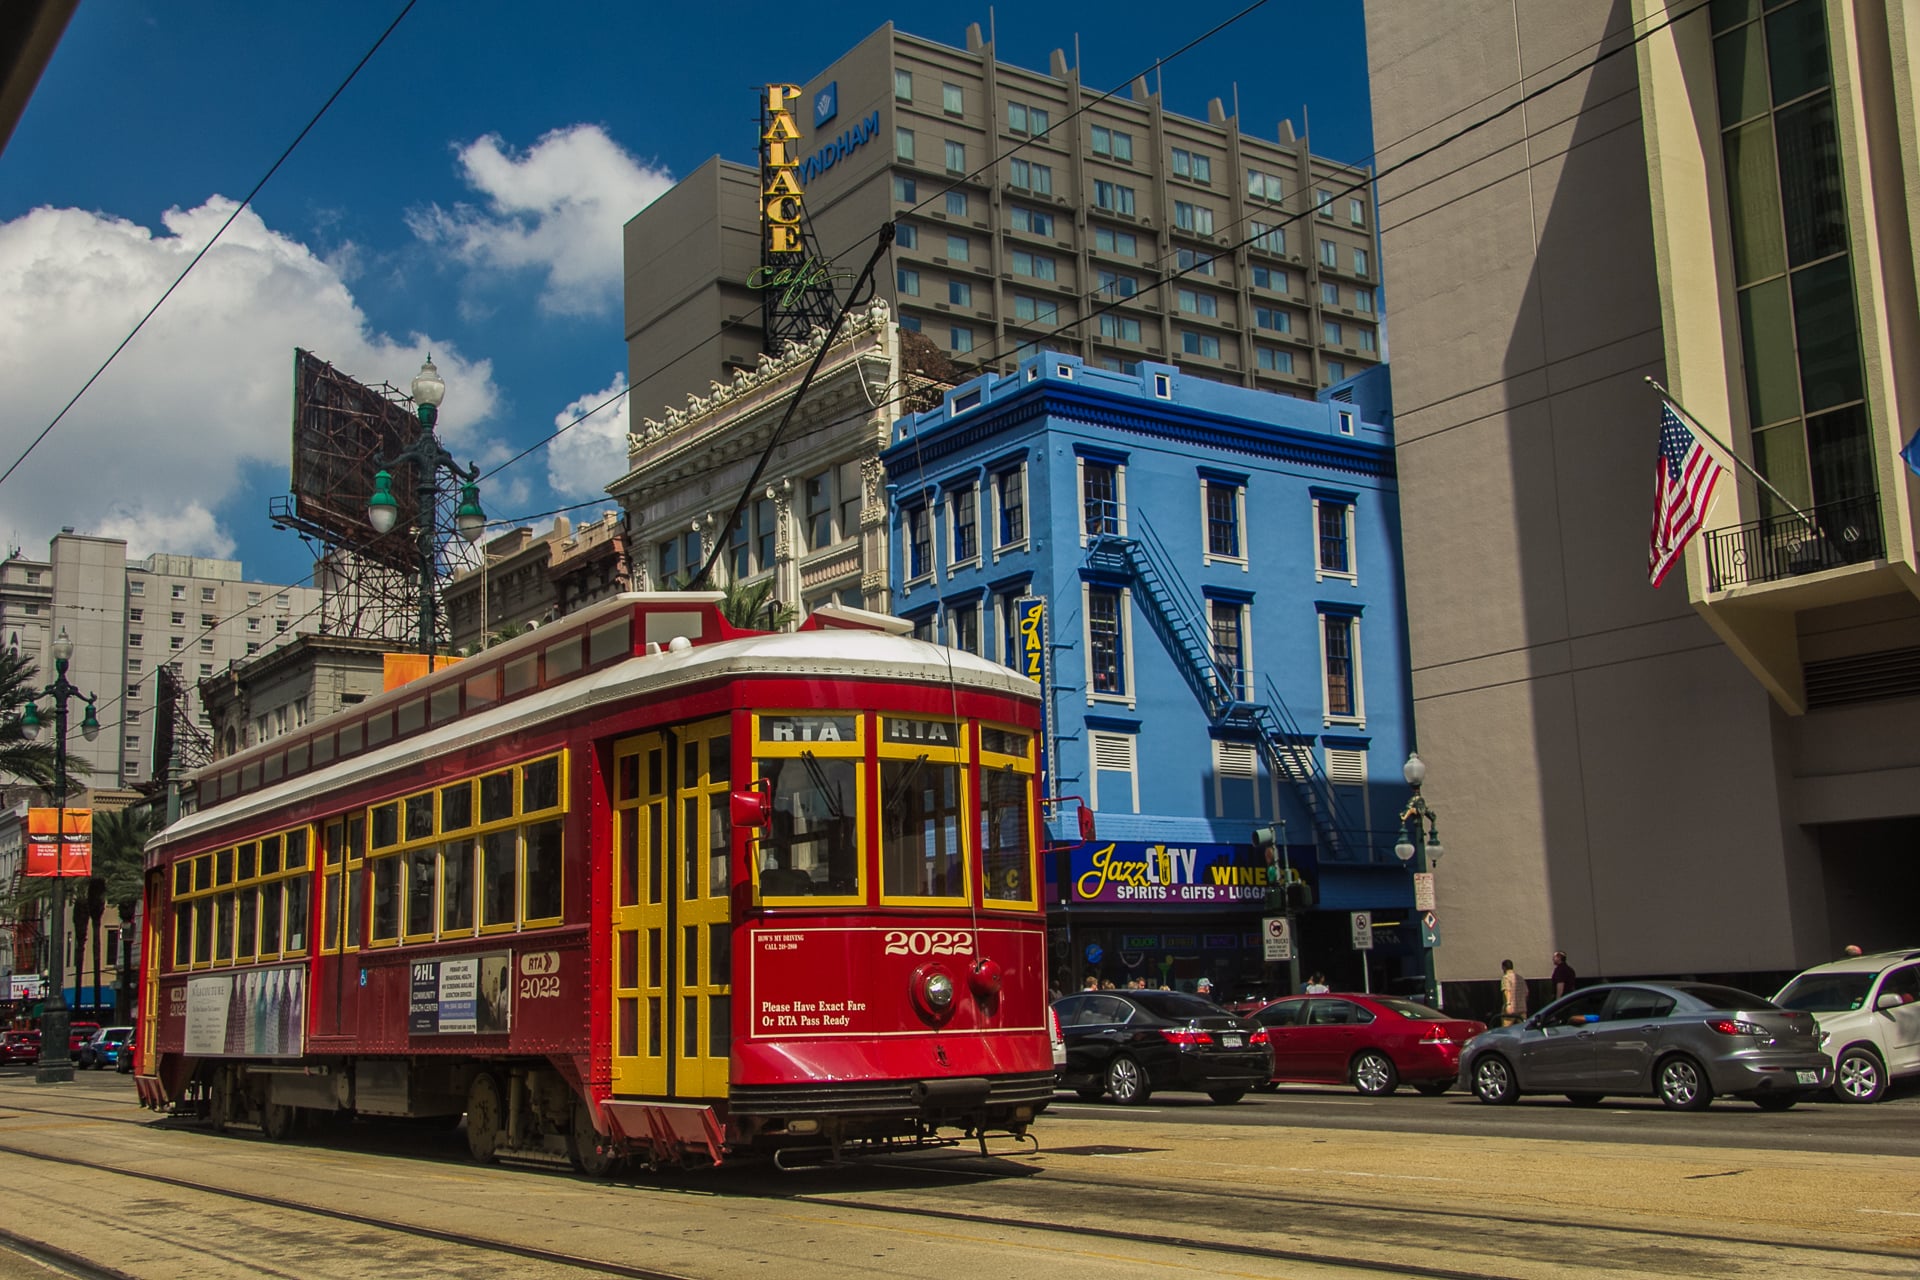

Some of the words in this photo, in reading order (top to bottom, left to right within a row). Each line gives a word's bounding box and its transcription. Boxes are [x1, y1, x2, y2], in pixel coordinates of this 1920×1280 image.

[799, 110, 879, 185] YNDHAM
[763, 83, 805, 252] PALACE
[773, 721, 841, 741] RTA
[891, 719, 948, 741] RTA
[1077, 843, 1151, 899] Jazz
[1211, 866, 1267, 886] WINE
[1117, 885, 1167, 900] SPIRITS
[1181, 886, 1215, 900] GIFTS
[1229, 886, 1266, 899] LUGGA
[783, 934, 804, 942] DRIVING
[884, 931, 973, 956] 2022
[528, 957, 543, 970] RTA
[412, 991, 436, 1000] COMMUNITY
[520, 976, 560, 999] 2022
[762, 1001, 790, 1012] Please
[793, 1001, 815, 1012] Have
[819, 1000, 844, 1011] Exact
[847, 1000, 866, 1011] Fare
[762, 1015, 775, 1027] Or
[777, 1015, 797, 1026] RTA
[800, 1015, 820, 1026] Pass
[823, 1014, 850, 1027] Ready
